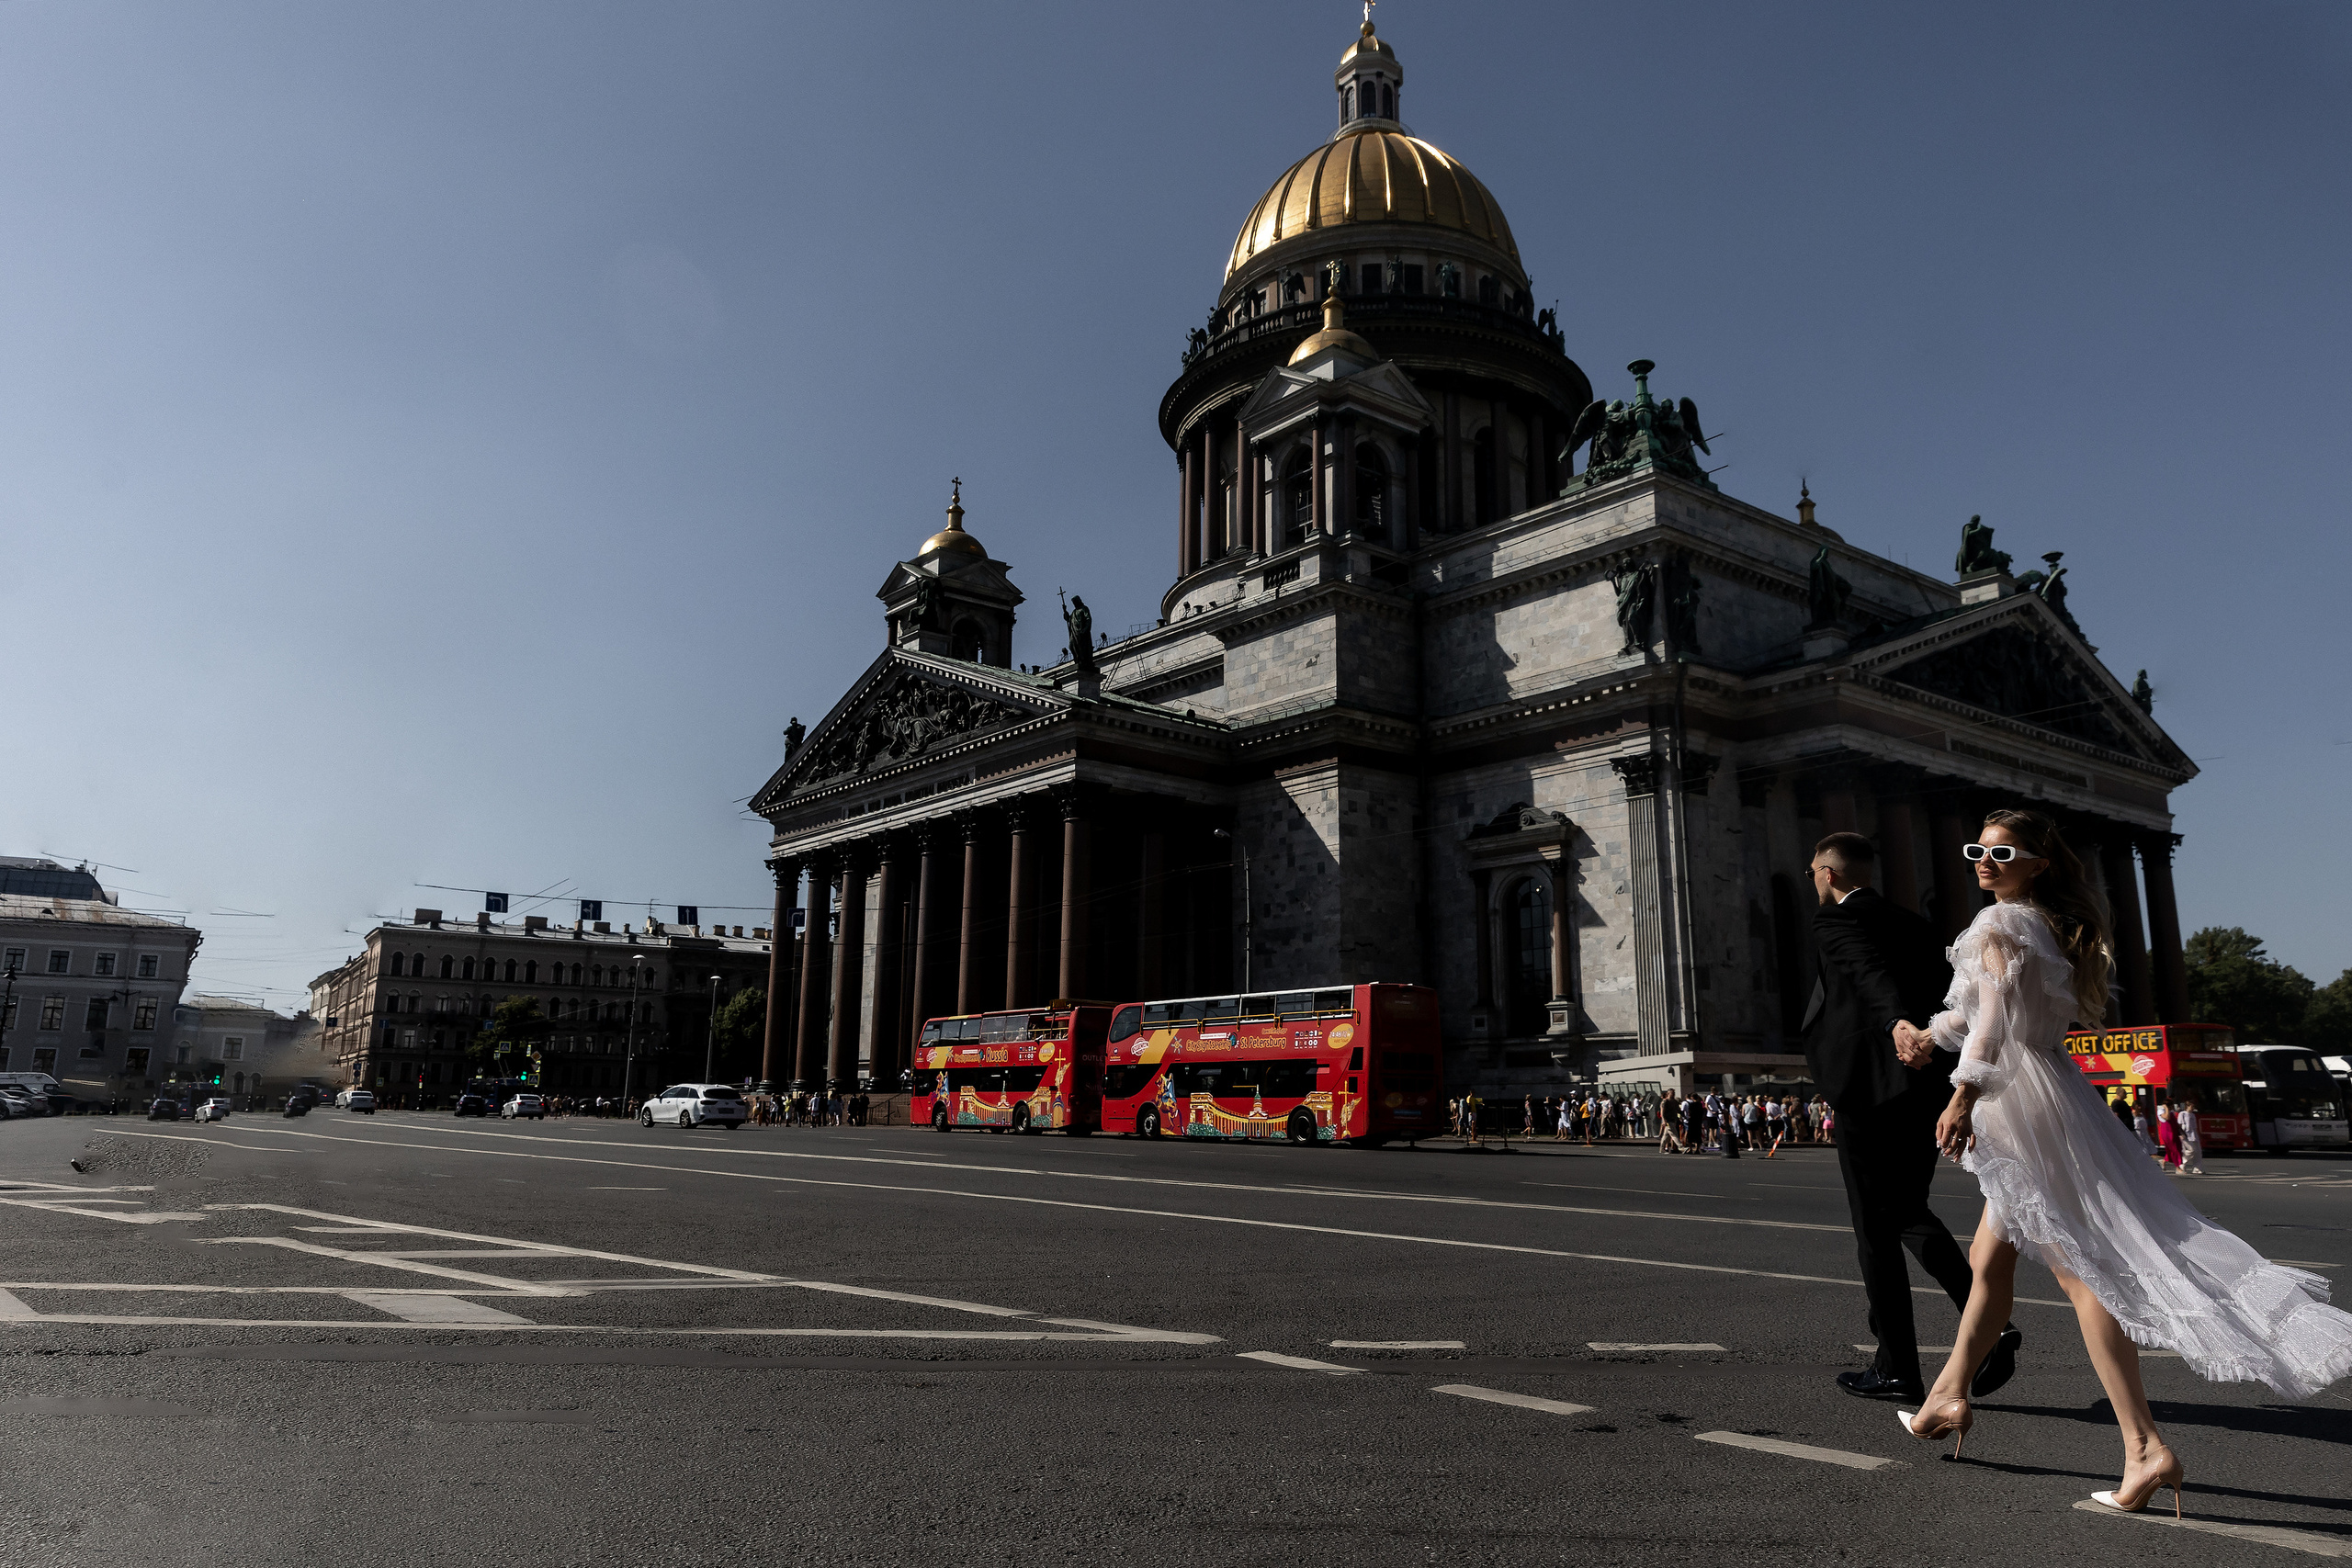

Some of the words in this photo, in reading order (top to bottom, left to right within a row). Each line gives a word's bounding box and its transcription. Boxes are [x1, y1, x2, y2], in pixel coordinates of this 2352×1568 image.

[1248, 1034, 1286, 1050] Petersburg
[2102, 1032, 2158, 1053] OFFICE
[986, 1046, 1009, 1063] Russia
